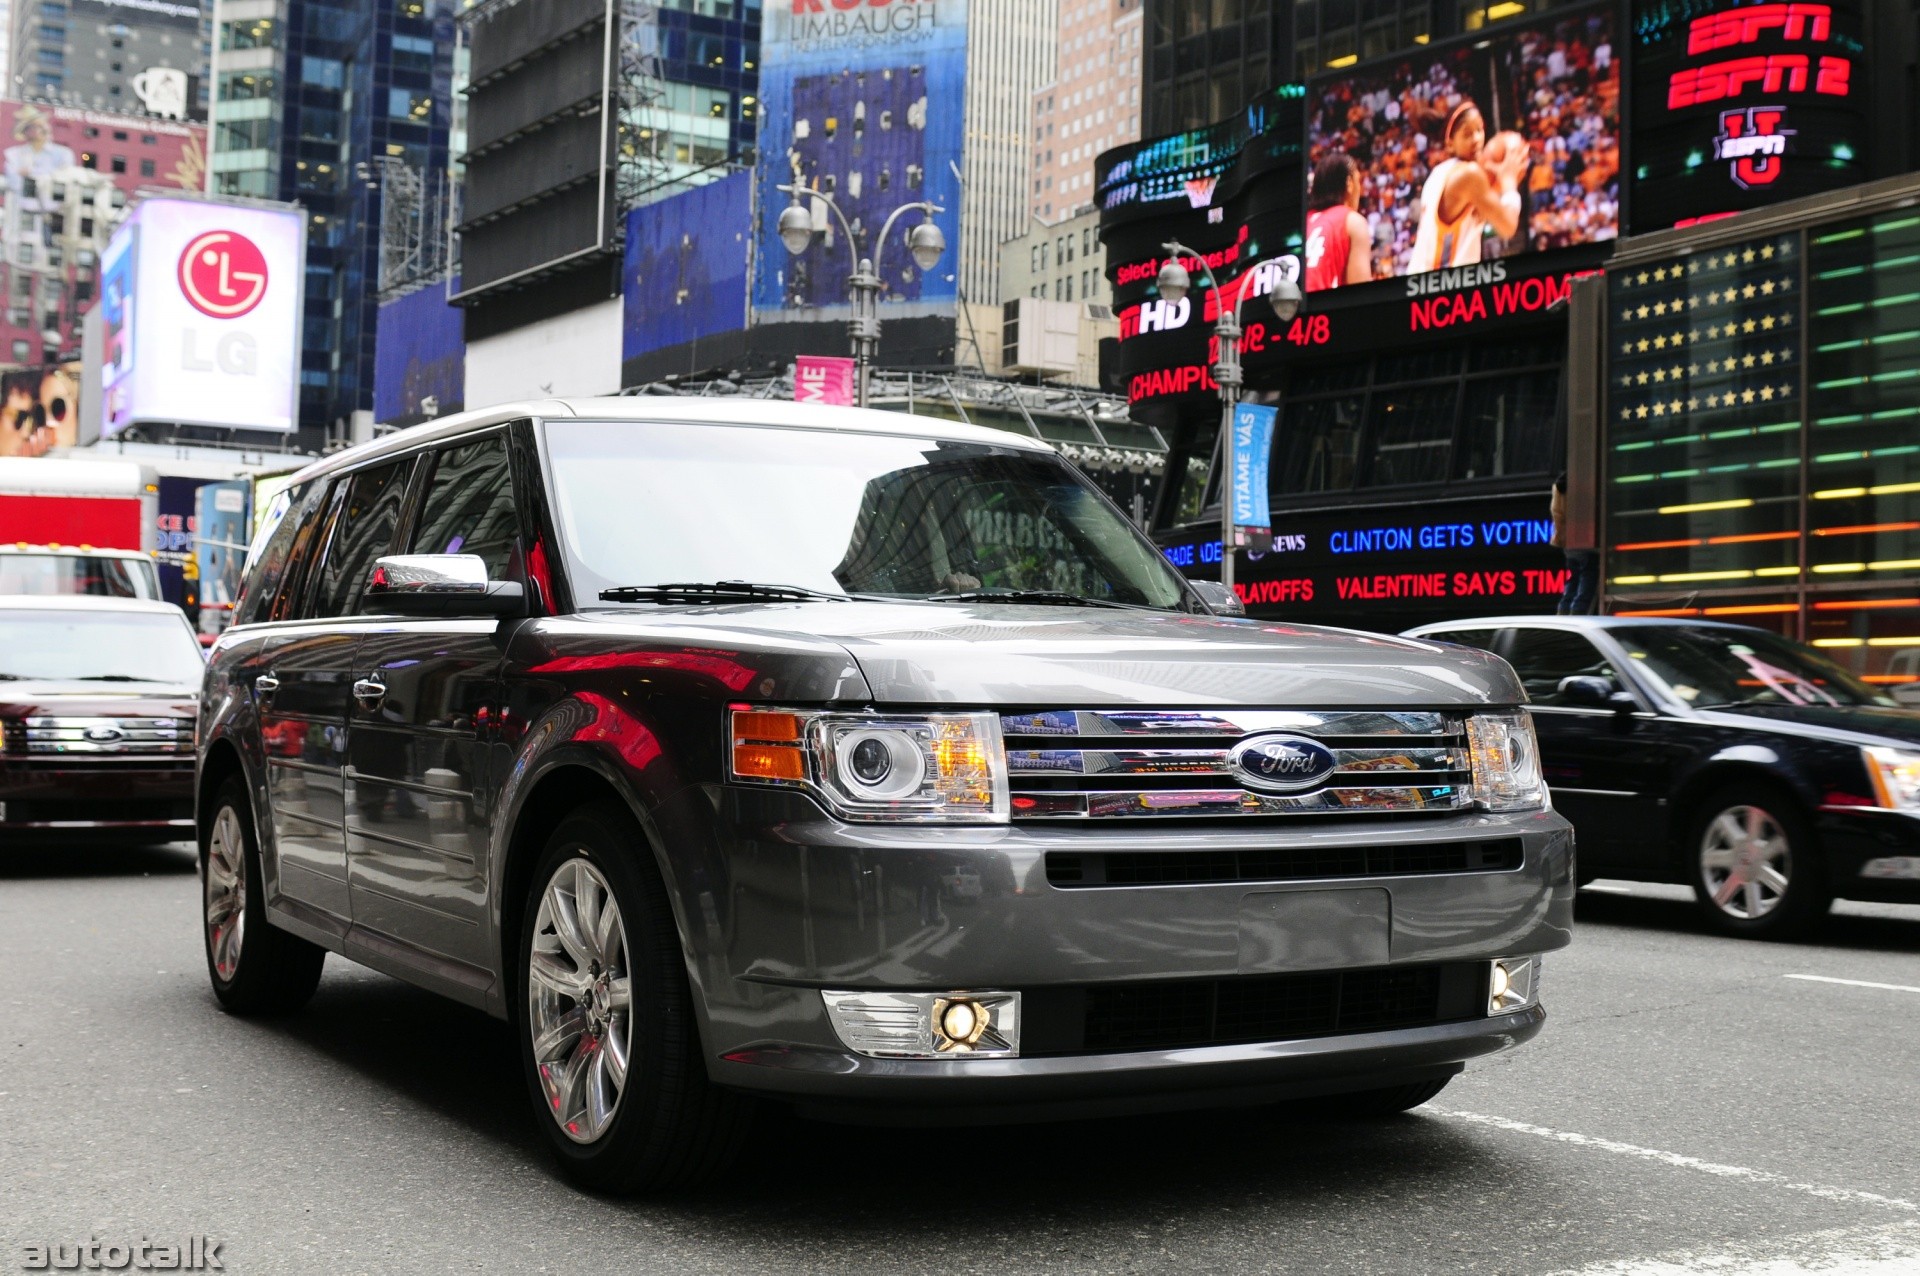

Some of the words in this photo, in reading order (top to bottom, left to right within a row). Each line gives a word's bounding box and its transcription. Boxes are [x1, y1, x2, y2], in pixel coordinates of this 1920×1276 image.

[791, 4, 936, 41] LIMBAUGH
[1688, 3, 1832, 55] ESPN
[1667, 54, 1810, 110] ESPN
[1816, 56, 1850, 96] 2
[1721, 134, 1786, 159] ESPN
[180, 231, 267, 318] LG
[1117, 258, 1157, 285] Select
[1406, 260, 1507, 297] SIEMENS
[1287, 313, 1330, 346] 4/8
[1410, 290, 1488, 332] NCAA
[181, 327, 257, 377] LG
[1131, 365, 1221, 402] CHAMPI
[1329, 527, 1413, 553] CLINTON
[1419, 523, 1474, 548] GETS
[1481, 518, 1554, 545] VOTIN
[1232, 578, 1314, 605] PLAYOFFS
[1336, 572, 1447, 599] VALENTINE
[1453, 570, 1516, 596] SAYS
[1261, 744, 1317, 774] Ford
